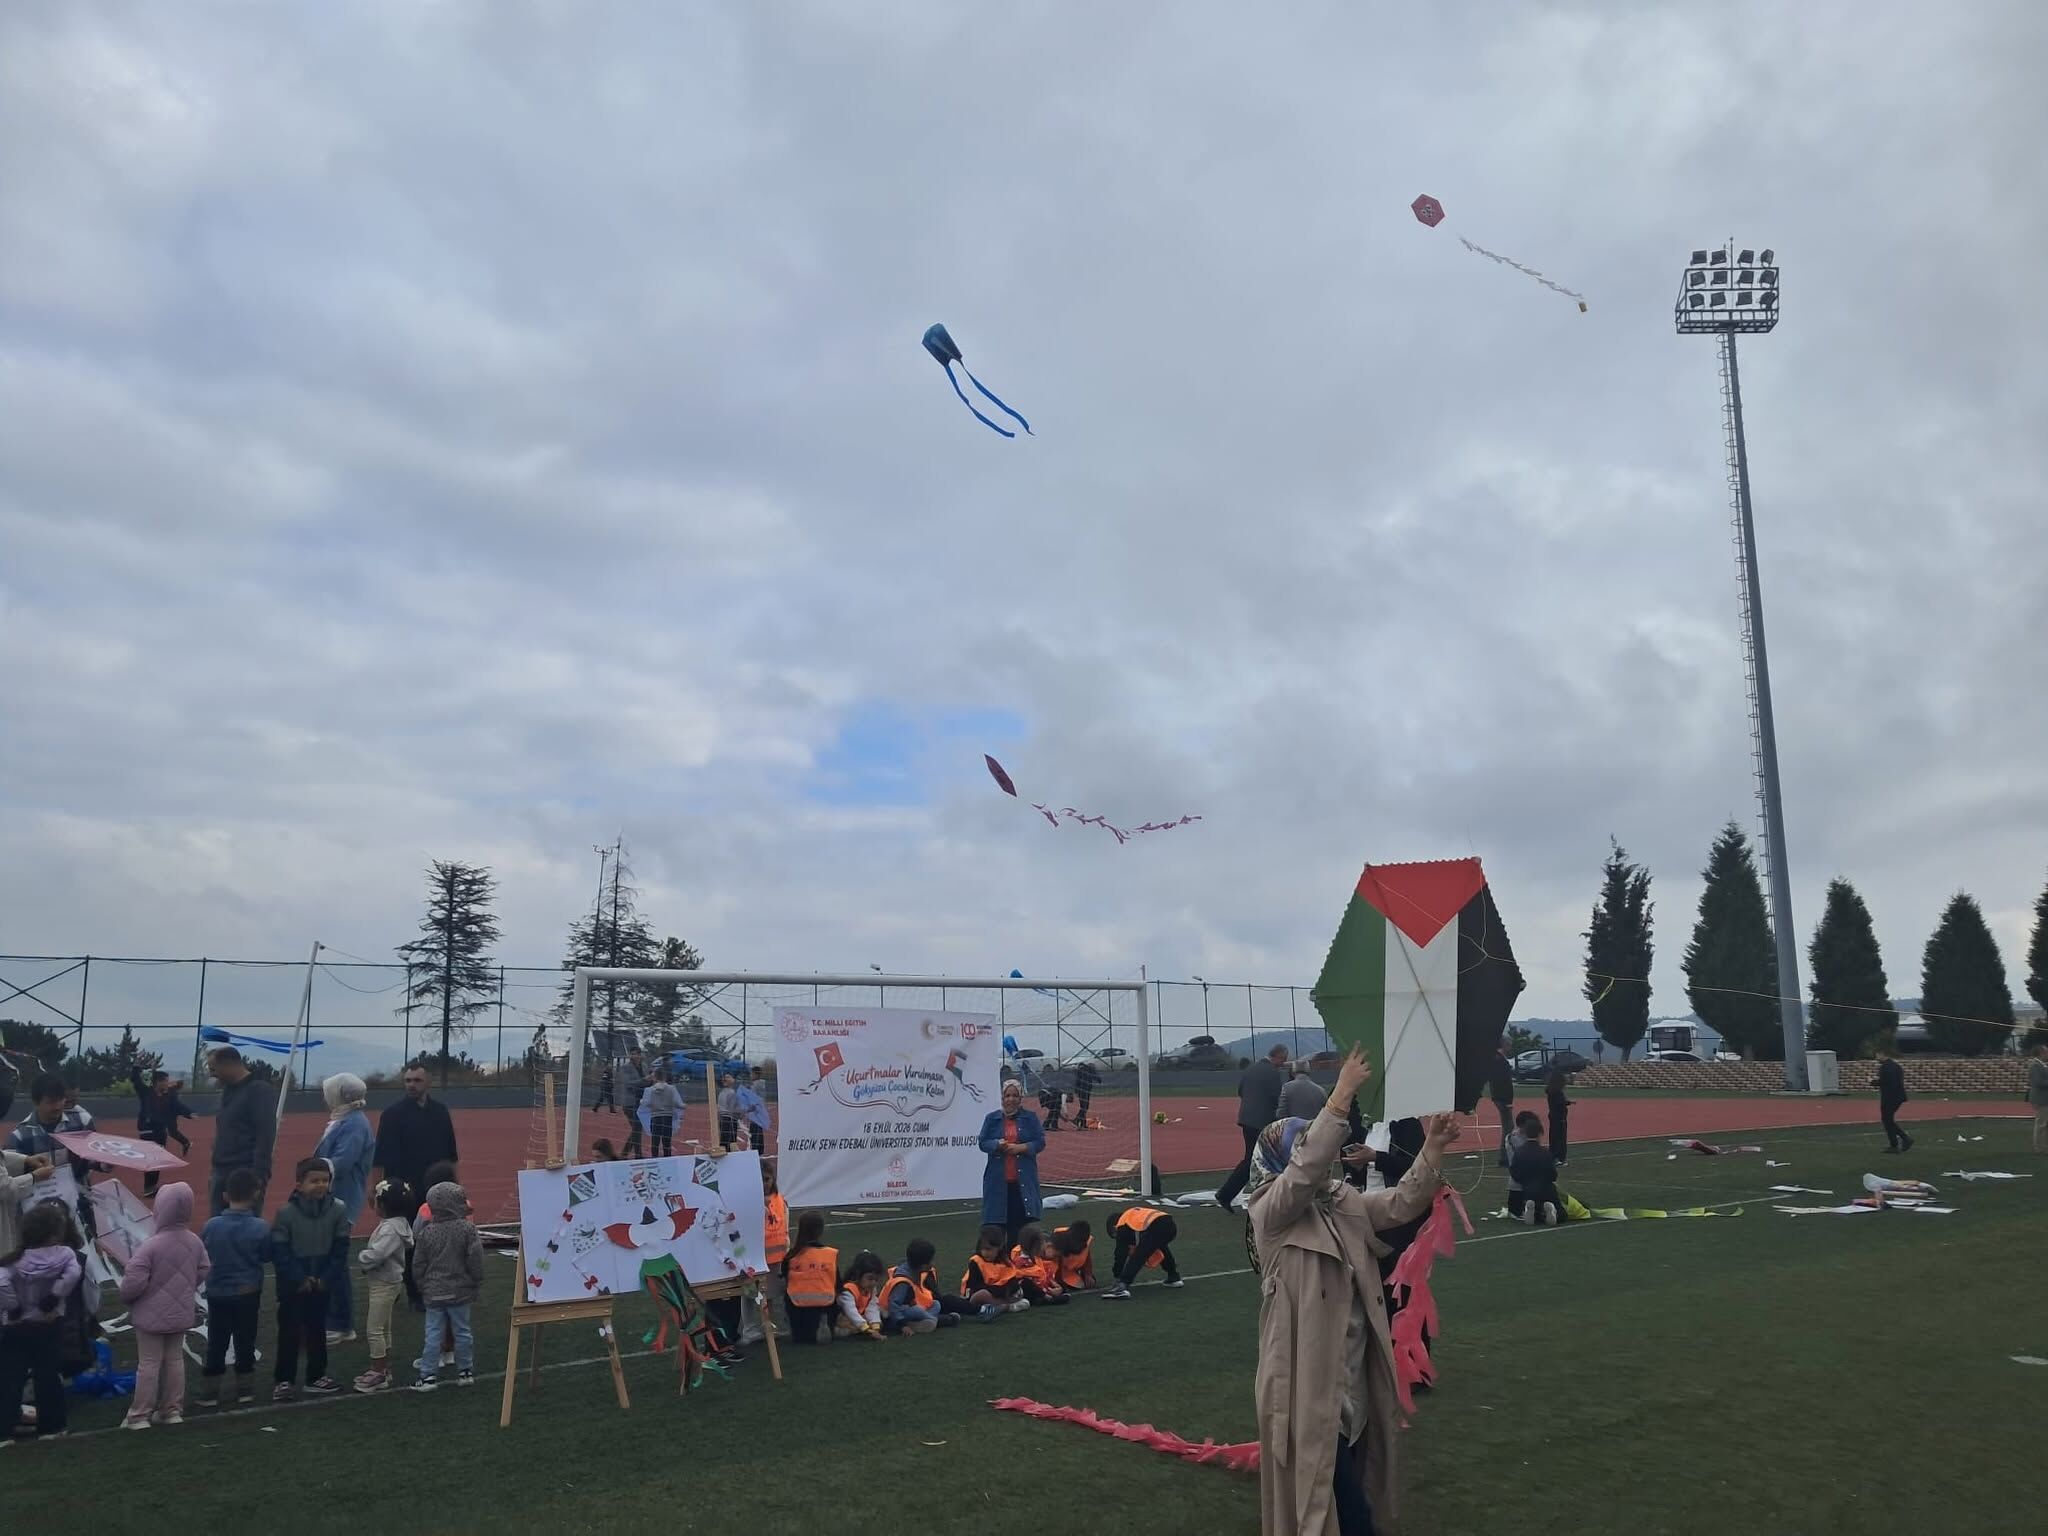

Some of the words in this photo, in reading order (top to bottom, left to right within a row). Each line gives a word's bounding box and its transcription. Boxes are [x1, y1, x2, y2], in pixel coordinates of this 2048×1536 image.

[846, 1064, 902, 1085] Uçurtmalar
[853, 1082, 887, 1100] Gökyüzü
[888, 1080, 924, 1095] Çocuklara
[925, 1083, 945, 1097] Kalsın
[873, 1120, 891, 1133] EYLÜL
[894, 1122, 911, 1133] 2026
[913, 1122, 930, 1133] CUMA
[788, 1138, 817, 1151] BİLECİK
[819, 1138, 837, 1151] ŞEYH
[839, 1138, 868, 1150] EDEBALİ
[870, 1136, 912, 1149] ÜNİVERSİTESİ
